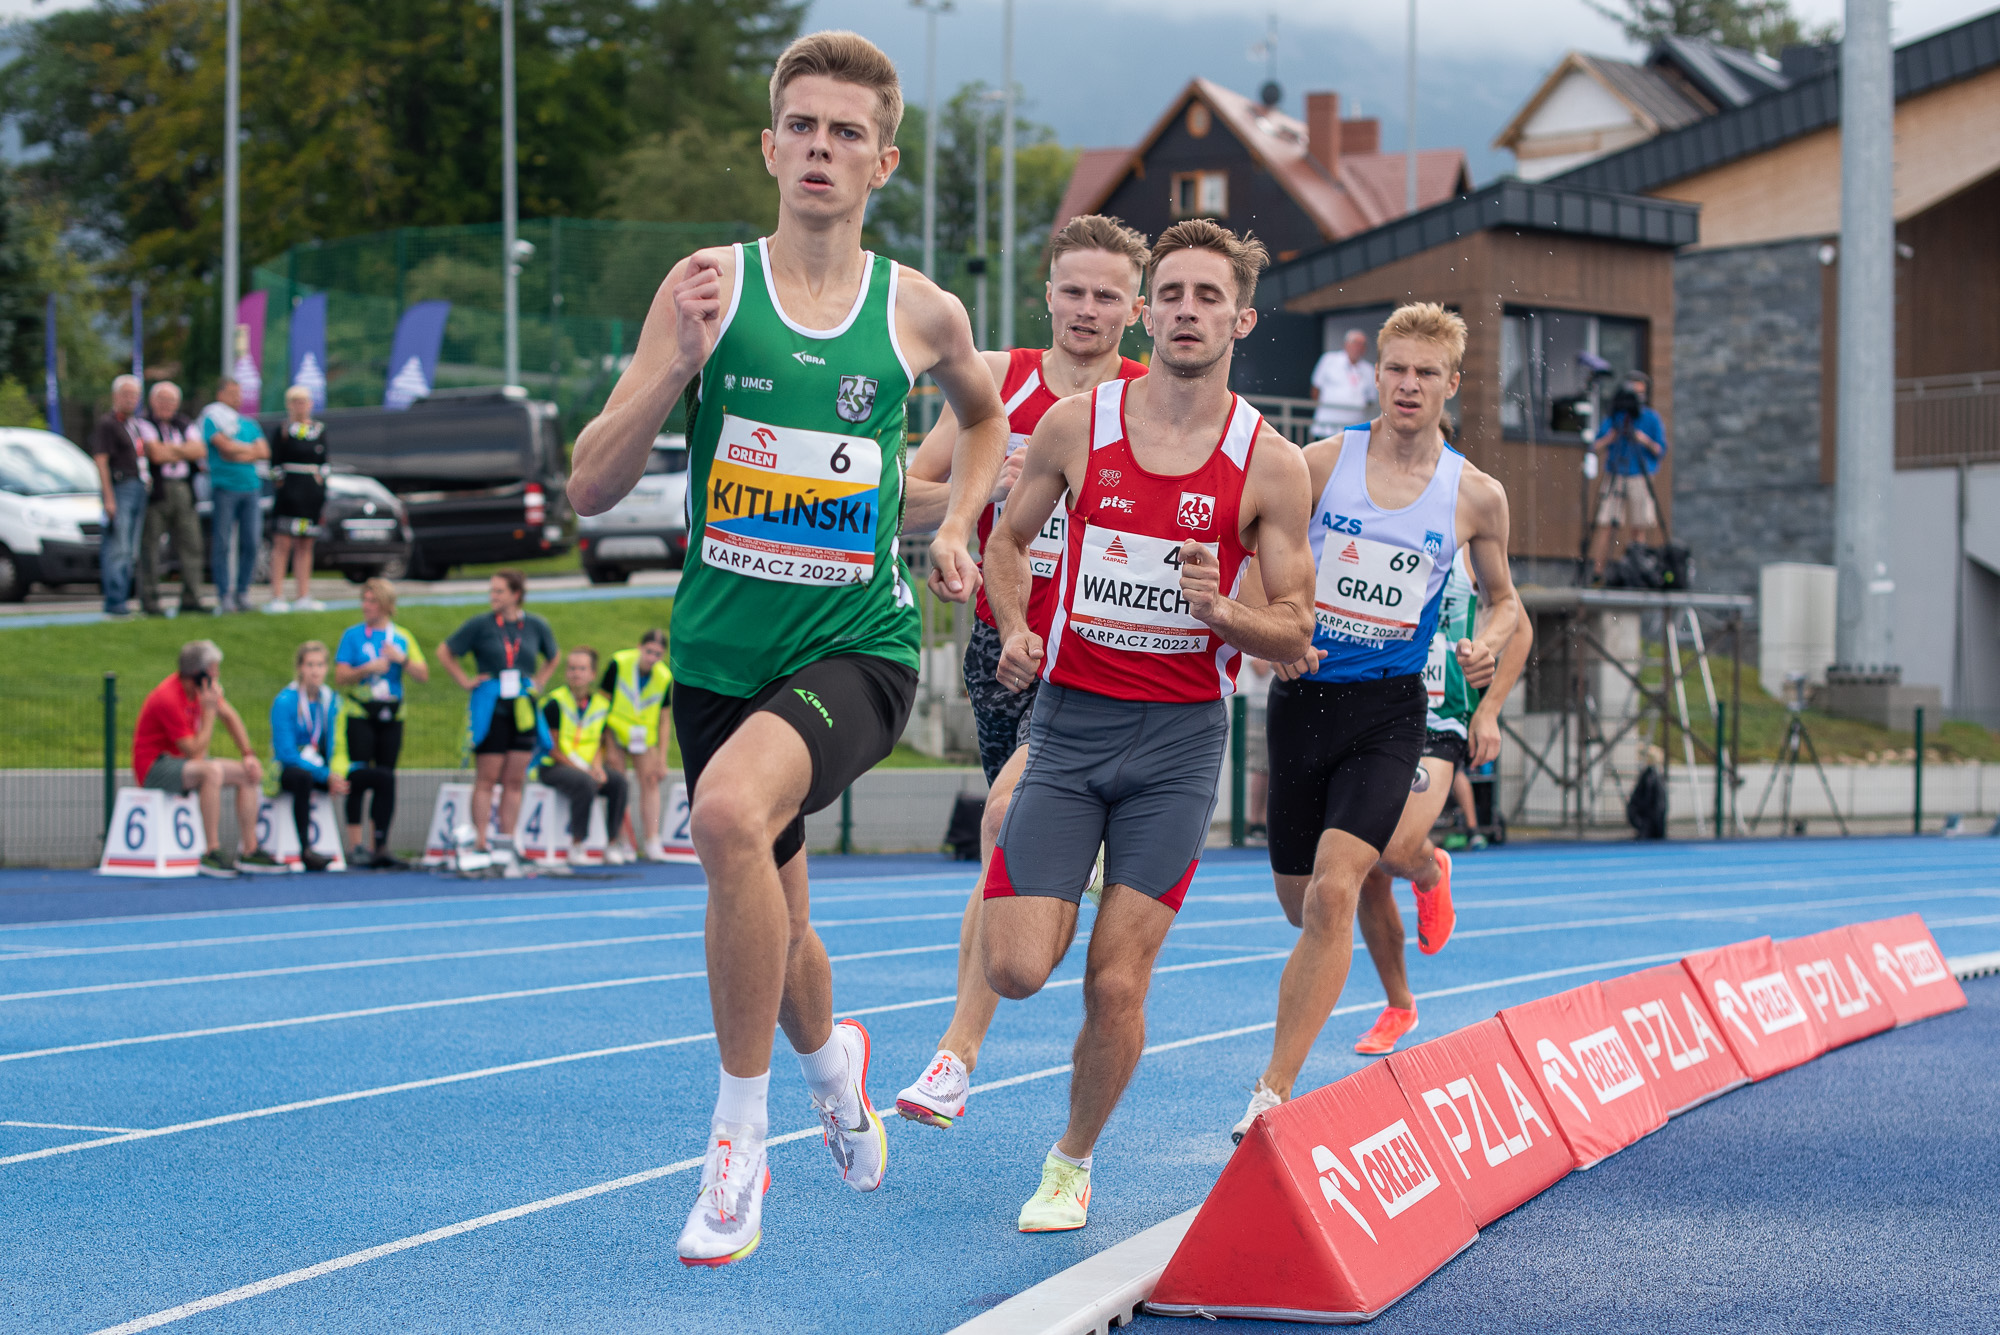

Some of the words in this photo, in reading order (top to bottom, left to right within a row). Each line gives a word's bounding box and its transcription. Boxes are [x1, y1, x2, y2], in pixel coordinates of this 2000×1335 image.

[741, 376, 773, 391] UMCS
[730, 445, 775, 468] ORLEN
[829, 442, 851, 474] 6
[713, 478, 872, 535] KITLIŃSKI
[1321, 511, 1363, 535] AZS
[708, 545, 795, 577] KARPACZ
[800, 563, 847, 582] 2022
[1102, 556, 1128, 565] KARPACZ
[1389, 551, 1420, 574] 69
[1337, 576, 1403, 607] GRAD
[1076, 626, 1149, 648] KARPACZ
[1152, 637, 1189, 650] 2022
[1315, 611, 1370, 635] KARPACZ
[1371, 626, 1400, 638] 2022
[125, 806, 147, 851] 6
[173, 806, 195, 851] 6
[526, 802, 543, 842] 4
[673, 801, 690, 840] 2
[1751, 982, 1798, 1023] ORLEN
[1796, 953, 1882, 1024] PZLA
[1621, 992, 1725, 1080] PZLA
[1580, 1037, 1637, 1093] ORLEN
[1421, 1062, 1552, 1180] PZLA
[1362, 1131, 1432, 1205] ORLEN
